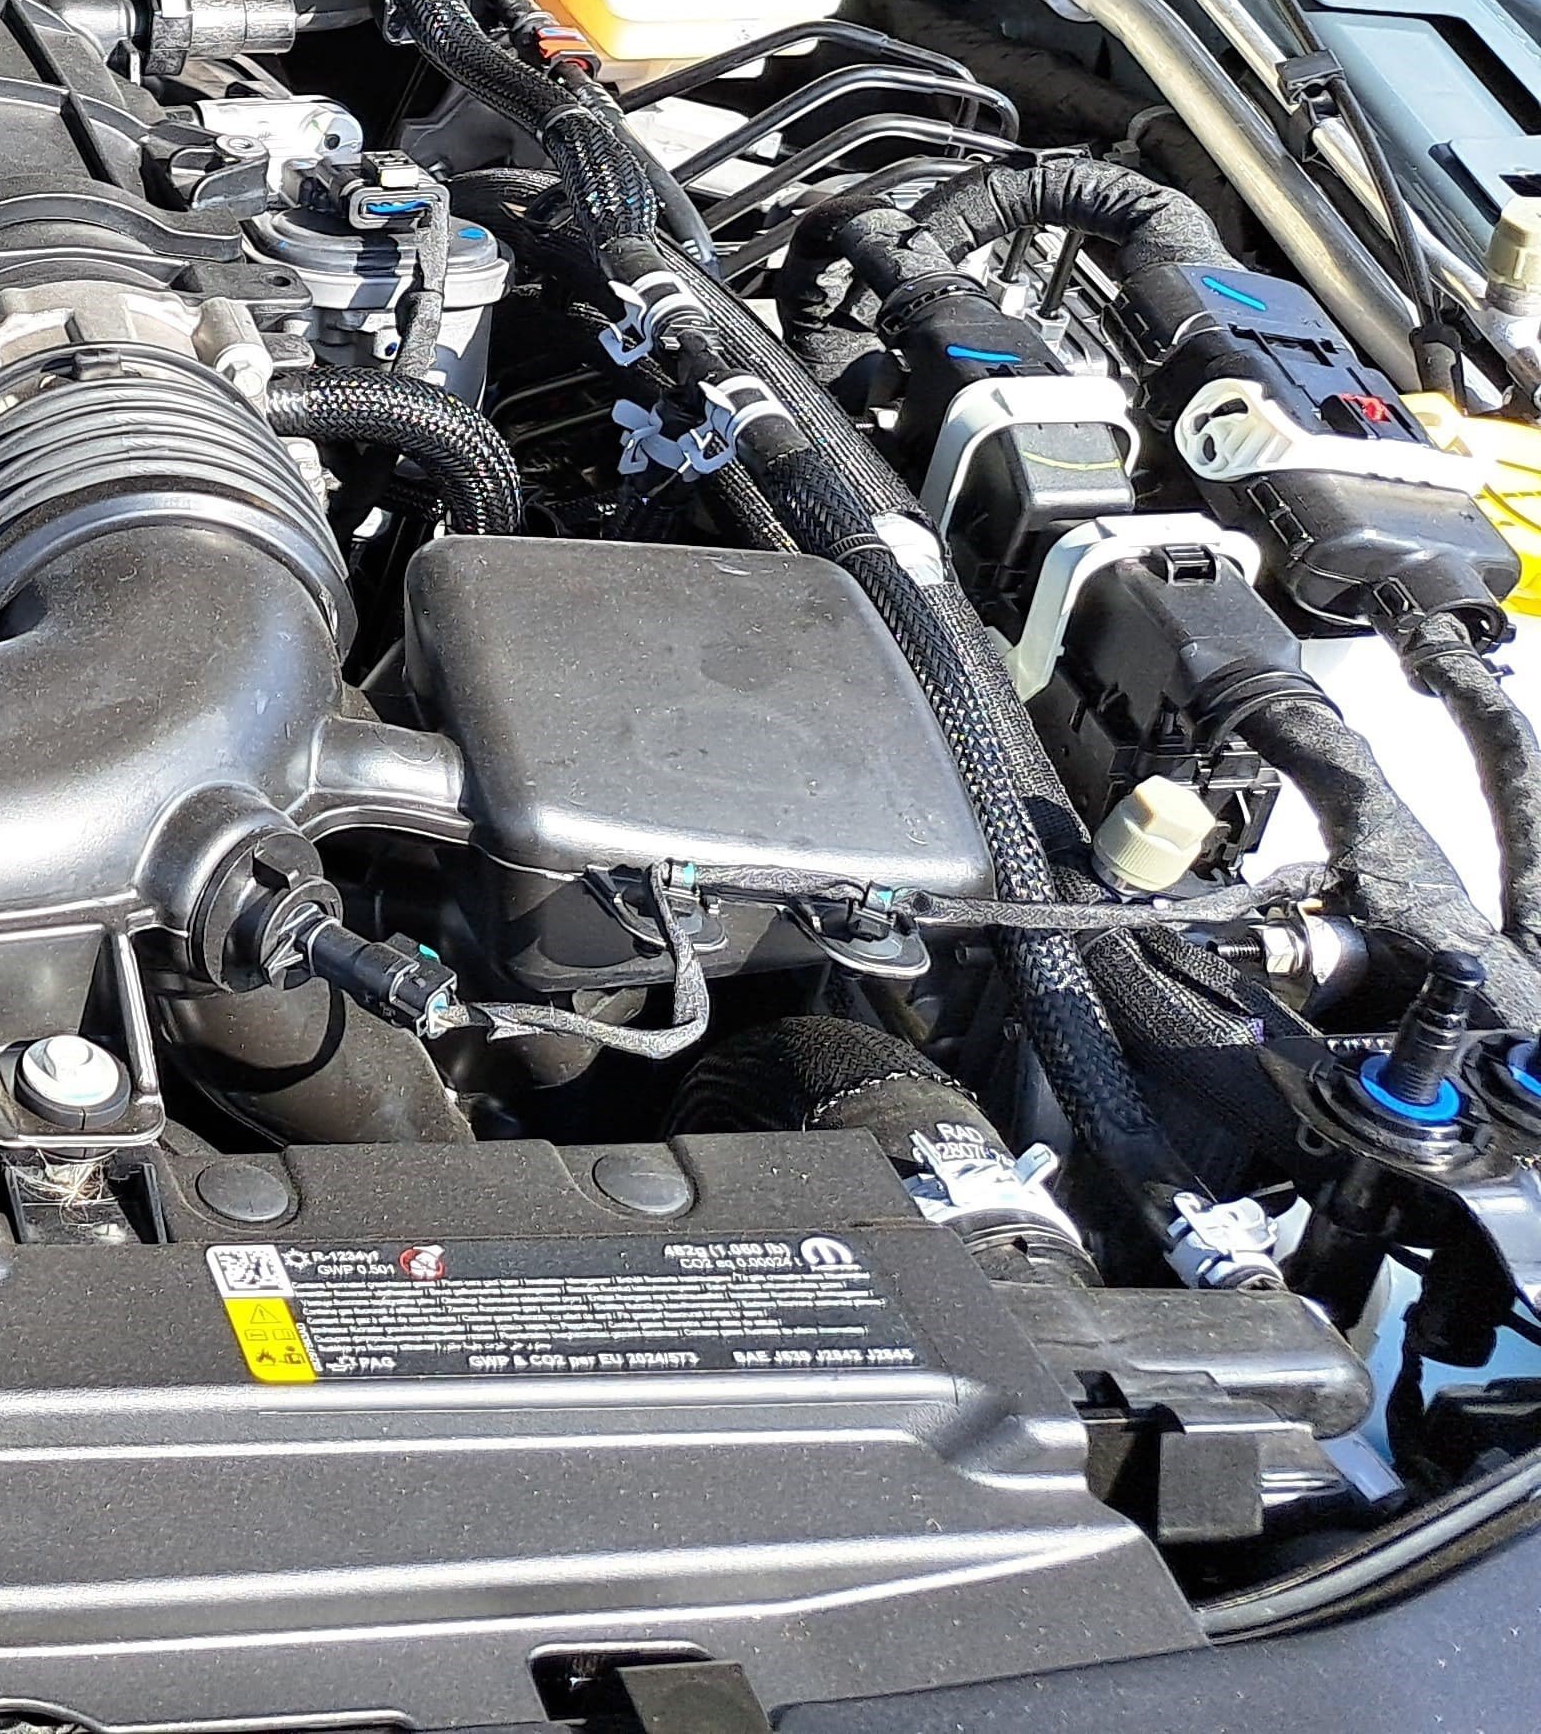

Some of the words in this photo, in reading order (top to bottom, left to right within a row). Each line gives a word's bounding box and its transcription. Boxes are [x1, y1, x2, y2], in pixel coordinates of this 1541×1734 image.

[935, 1123, 985, 1144] RAD
[664, 1243, 708, 1259] 482g
[316, 1264, 355, 1276] GWP
[356, 1264, 396, 1276] 0.501
[679, 1258, 713, 1270] CO2
[358, 1356, 397, 1369] PAG
[468, 1355, 510, 1368] GWP
[529, 1354, 567, 1367] CO2
[568, 1355, 597, 1369] per
[598, 1352, 624, 1366] EU
